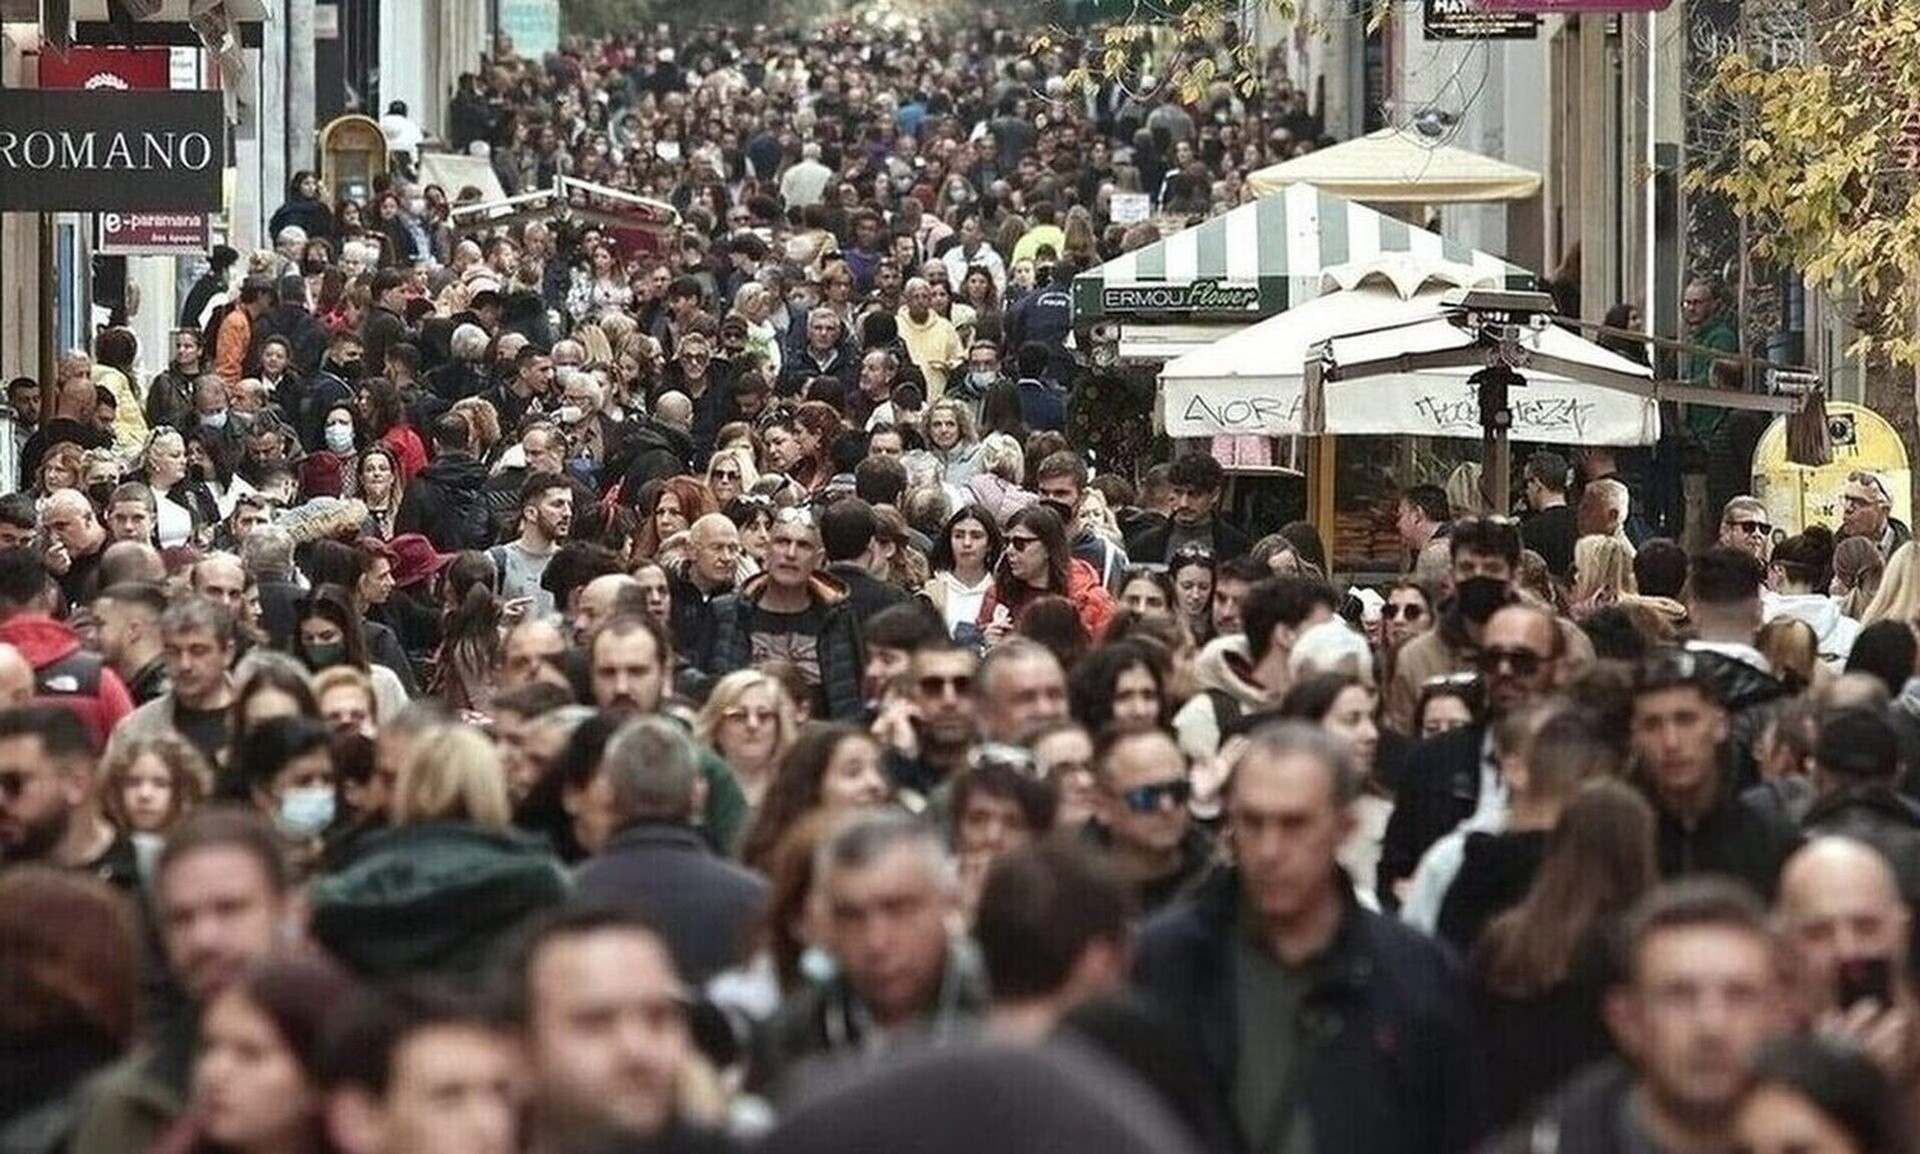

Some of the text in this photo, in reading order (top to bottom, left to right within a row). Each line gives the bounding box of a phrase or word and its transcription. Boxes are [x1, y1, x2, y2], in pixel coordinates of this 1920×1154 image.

[0, 131, 212, 169] ROMANO
[1105, 281, 1258, 306] ERMOU Flower
